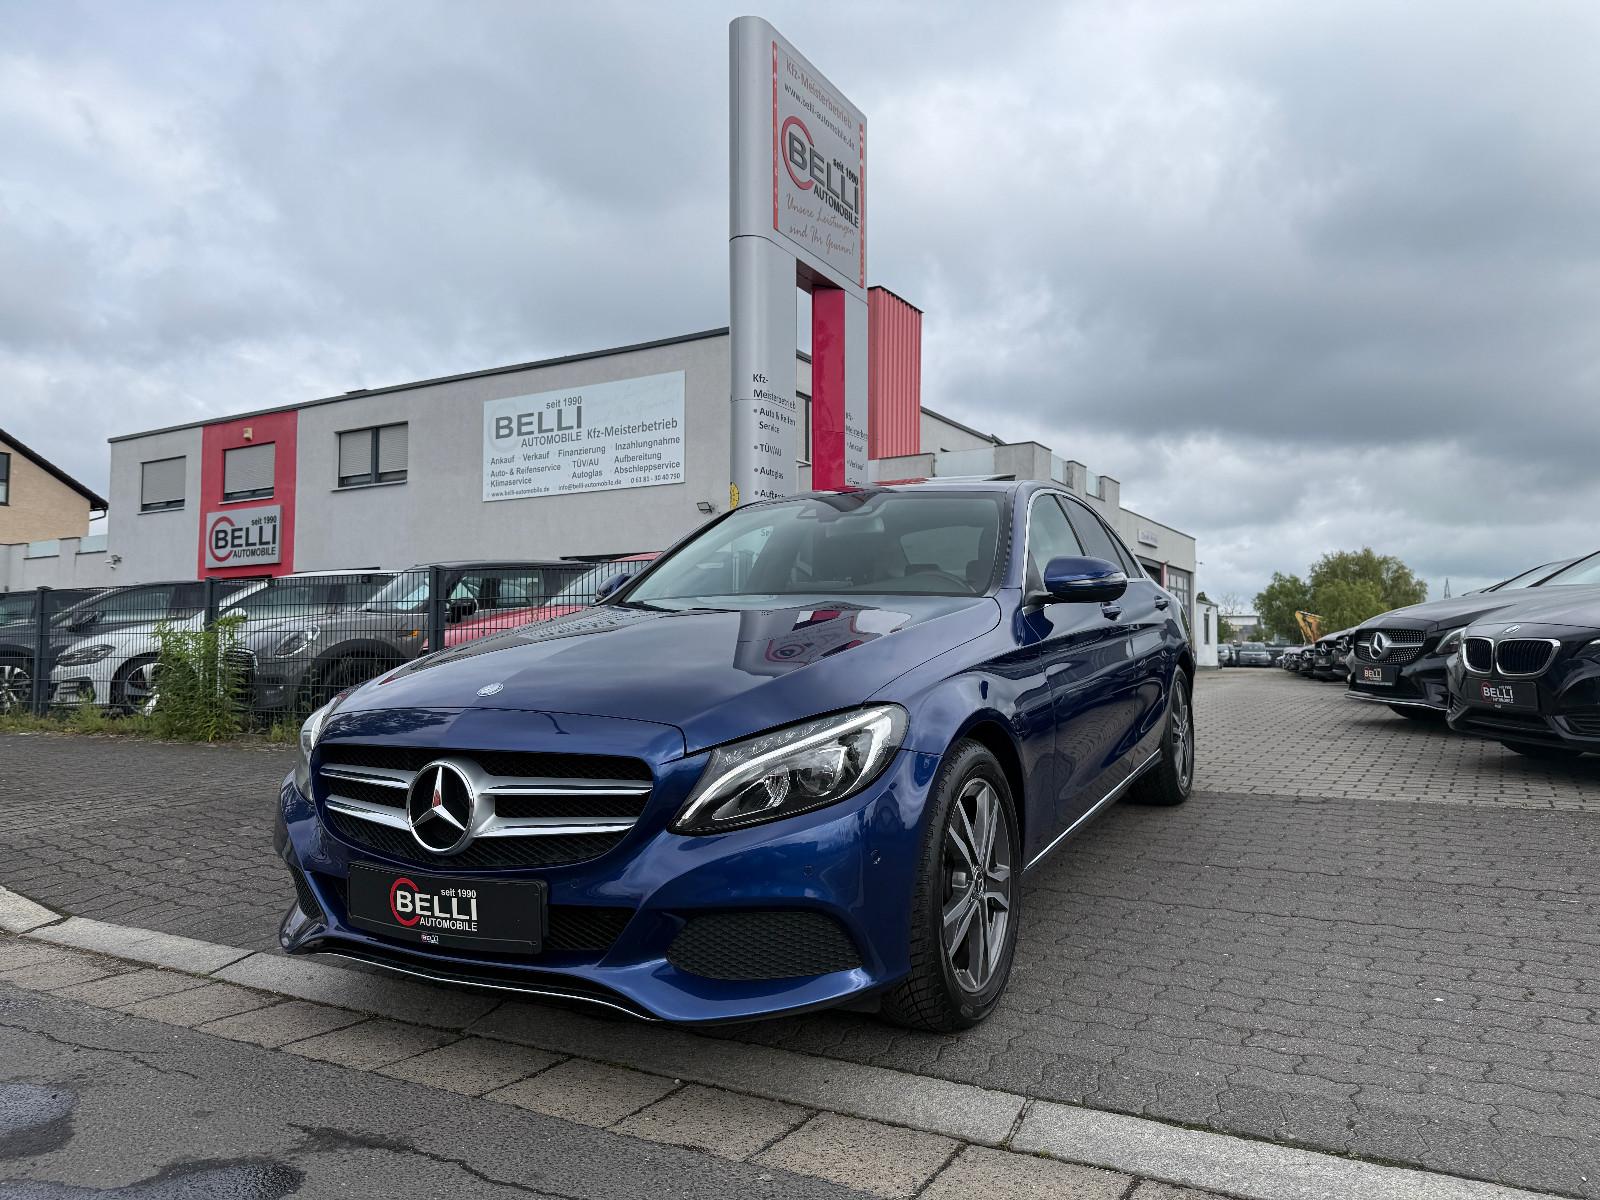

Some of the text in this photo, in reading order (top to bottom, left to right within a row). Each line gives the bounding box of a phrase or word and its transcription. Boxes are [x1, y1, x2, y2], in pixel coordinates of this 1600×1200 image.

[785, 56, 852, 129] Kfz-Meisterbetrieb
[789, 131, 859, 215] BELLI
[833, 158, 859, 186] seit 1990
[785, 193, 815, 218] Unsere
[813, 184, 859, 228] AUTOMOBILE
[752, 373, 769, 384] Kfz-
[546, 396, 582, 409] seit 1990
[495, 406, 582, 440] BELLI
[587, 417, 678, 439] Kfz-Meisterbetrieb
[521, 431, 582, 448] AUTOMOBILE
[490, 437, 680, 465] Ankauf Verkauf Finanzierung Inzahlungnahme
[614, 452, 662, 463] Aufbereitung
[572, 458, 599, 468] TÜV/AU
[614, 461, 680, 475] Abschleppservice
[490, 470, 508, 478] Auto-
[516, 464, 561, 475] Reifenservice
[572, 469, 603, 480] Autoglas
[490, 476, 532, 488] Klimaservice
[251, 515, 277, 526] seit 1990
[214, 524, 277, 549] BELLI
[233, 547, 276, 559] AUTOMOBILE
[1483, 686, 1514, 699] BELLI
[440, 888, 477, 898] seit 1990
[396, 890, 478, 921] BELLI
[419, 917, 478, 932] AUTOMOBILE
